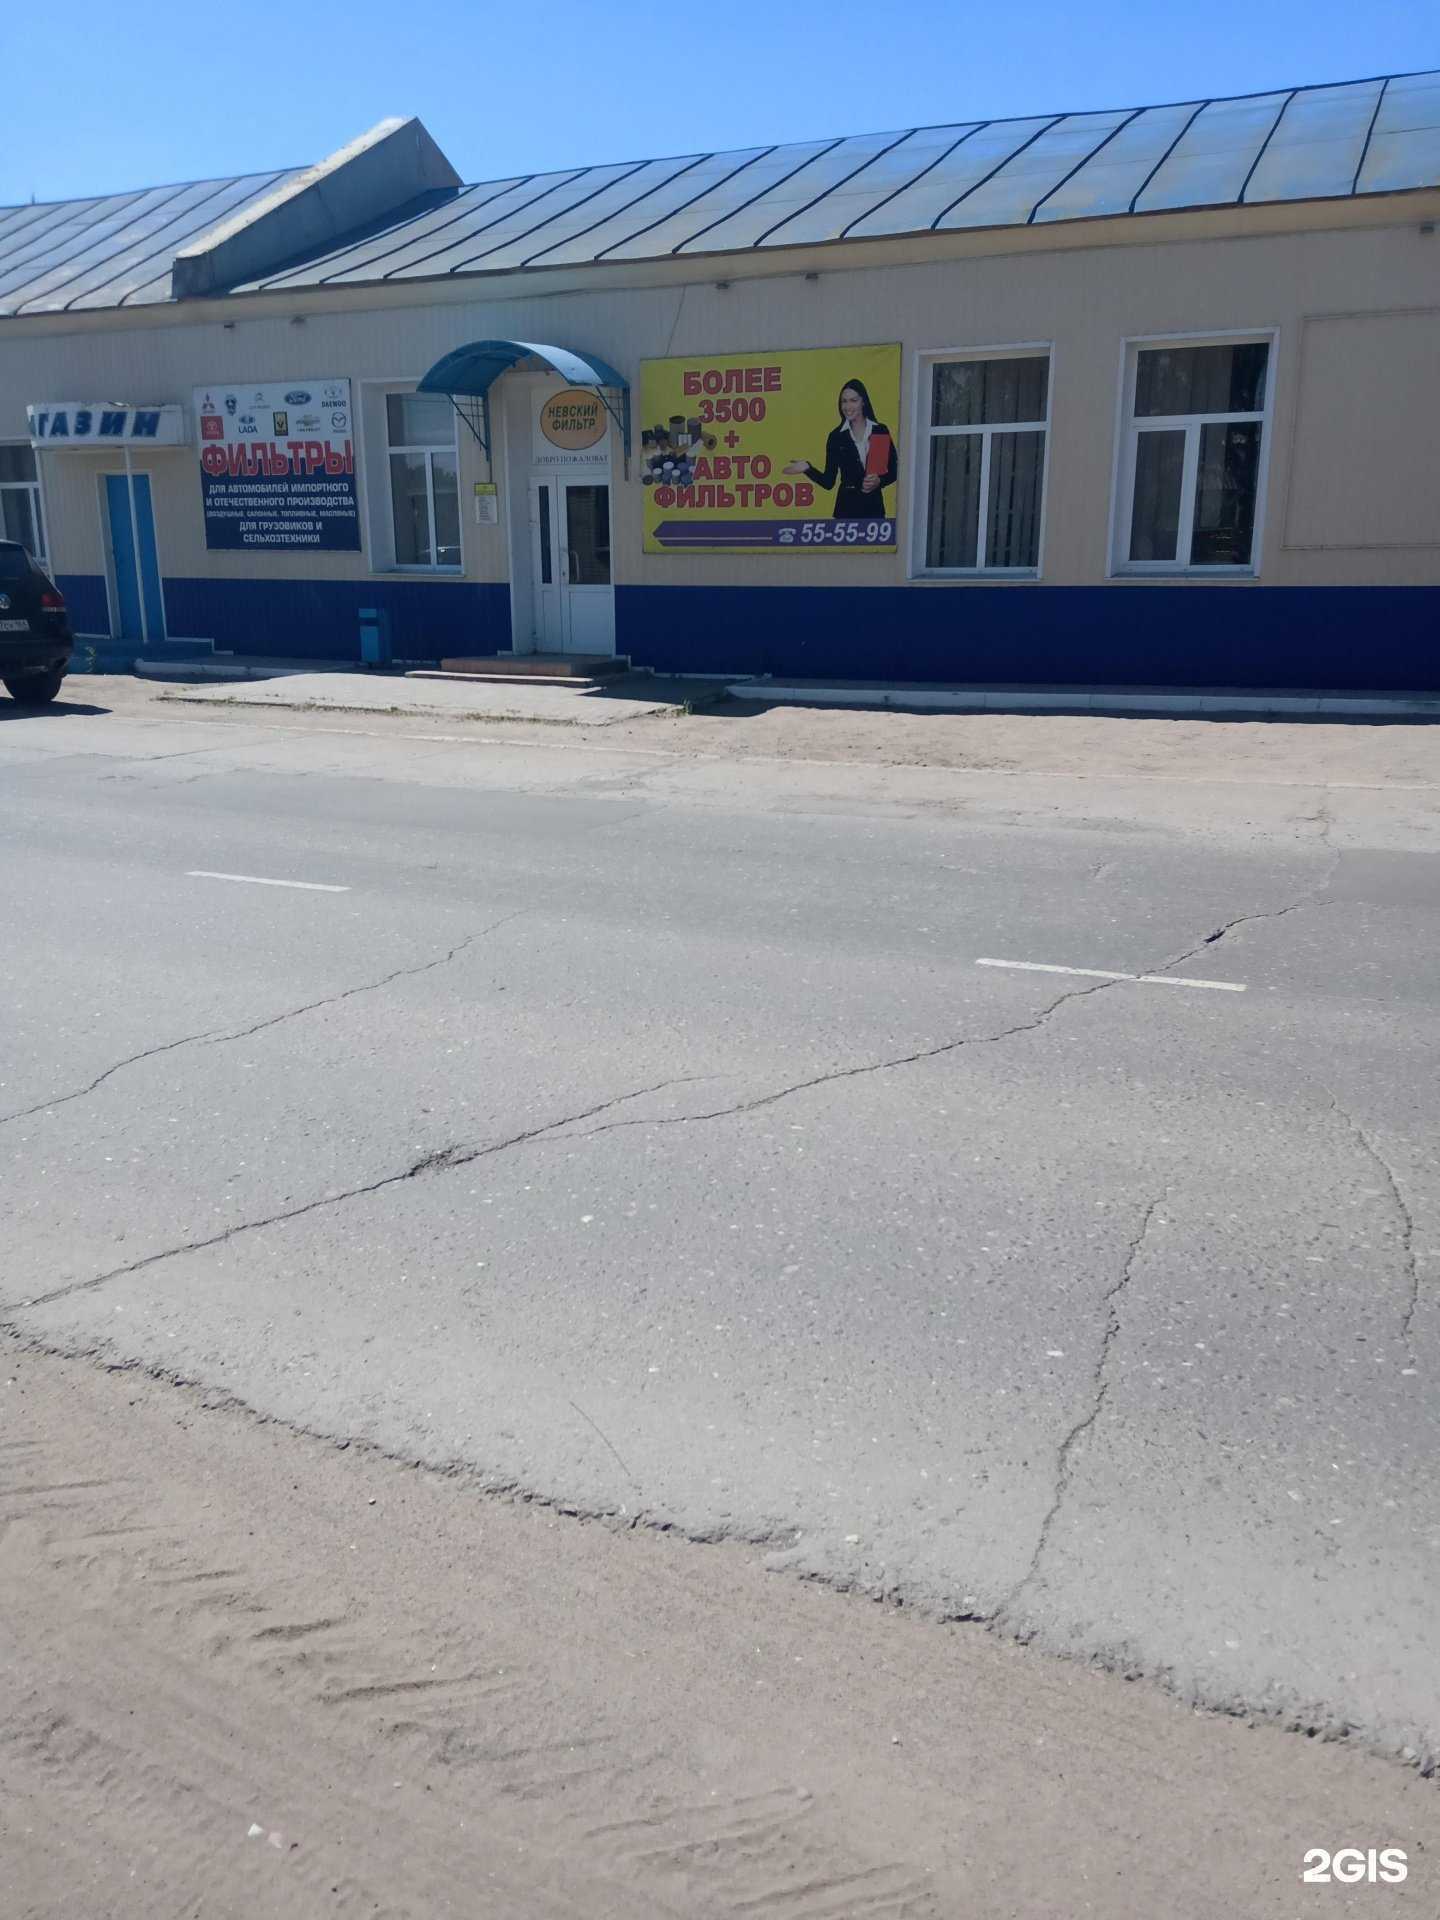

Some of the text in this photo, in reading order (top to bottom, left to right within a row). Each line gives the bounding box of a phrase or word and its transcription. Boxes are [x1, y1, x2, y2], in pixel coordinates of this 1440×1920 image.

[683, 366, 782, 395] БОЛЕЕ
[548, 402, 598, 418] НЕВСКИЙ
[698, 397, 766, 424] 3500
[238, 425, 258, 434] LADA
[552, 417, 596, 432] ФИЛЬТР
[723, 430, 740, 449] +
[202, 439, 354, 476] ФИЛЬТРЫ
[692, 454, 772, 480] АВТО
[209, 482, 349, 494] ДЛЯ АВТОМОБИЛЕЙ ИМПОРТНОГО
[653, 482, 815, 509] ФИЛЬТРОВ
[206, 497, 355, 507] И ОТЕЧЕСТВЕННОГО ПРОИЗВОДСТВА
[240, 521, 323, 532] ДЛЯ ГРУЗОВИКОВ И
[800, 522, 892, 543] 55-55-99
[243, 534, 320, 543] СЕЛЬХОЗТЕХНИКИ
